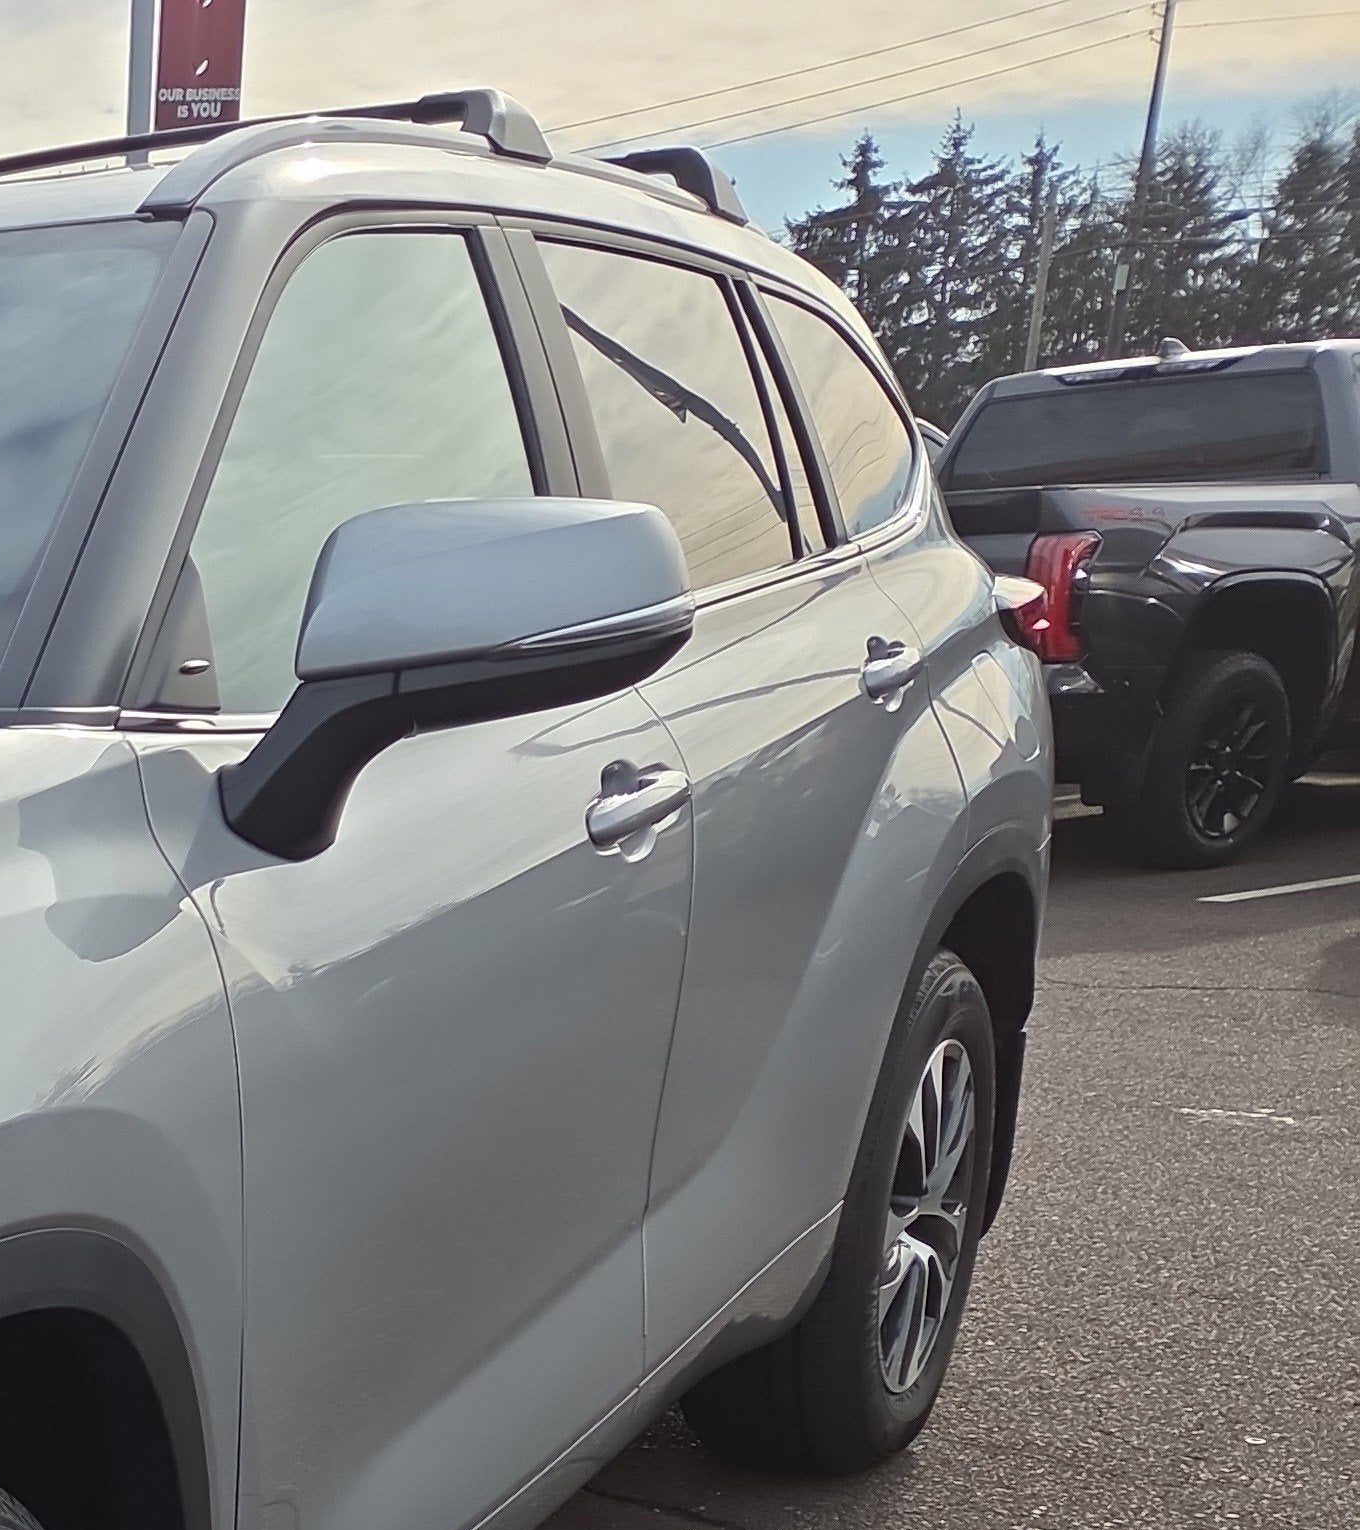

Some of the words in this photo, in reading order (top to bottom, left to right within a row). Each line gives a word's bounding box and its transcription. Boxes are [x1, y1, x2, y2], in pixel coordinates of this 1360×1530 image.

[159, 88, 184, 101] OUR
[186, 87, 240, 101] BUSINESS
[177, 105, 189, 118] IS
[191, 102, 221, 118] YOU
